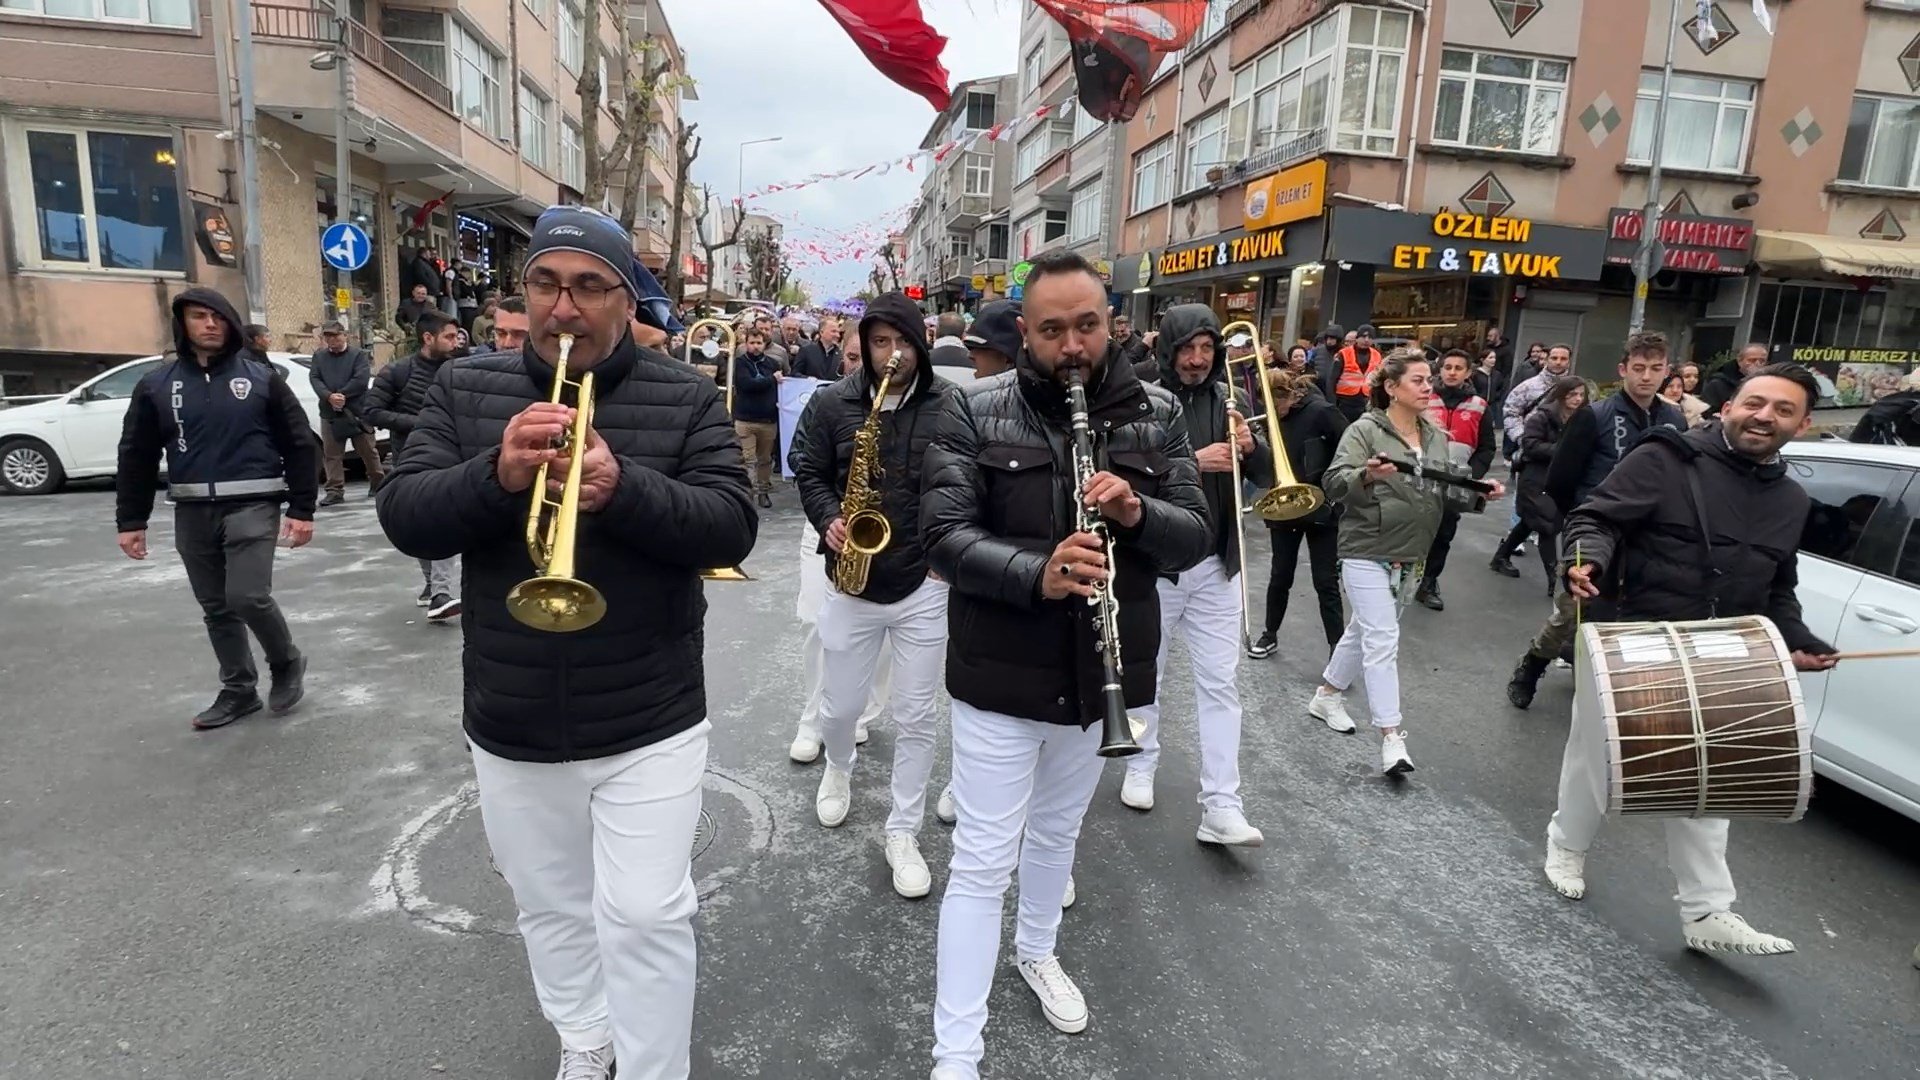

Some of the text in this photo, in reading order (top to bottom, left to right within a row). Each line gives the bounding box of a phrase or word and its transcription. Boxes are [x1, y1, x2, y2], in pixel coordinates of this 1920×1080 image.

[1302, 182, 1313, 199] ET
[1432, 206, 1530, 242] ÖZLEM
[1197, 244, 1215, 269] ET
[1216, 241, 1228, 265] &
[1231, 229, 1285, 263] TAVUK
[1394, 244, 1561, 278] ET & TAVUK
[1793, 346, 1846, 361] KÖYÜM
[1848, 350, 1909, 363] MERKEZ
